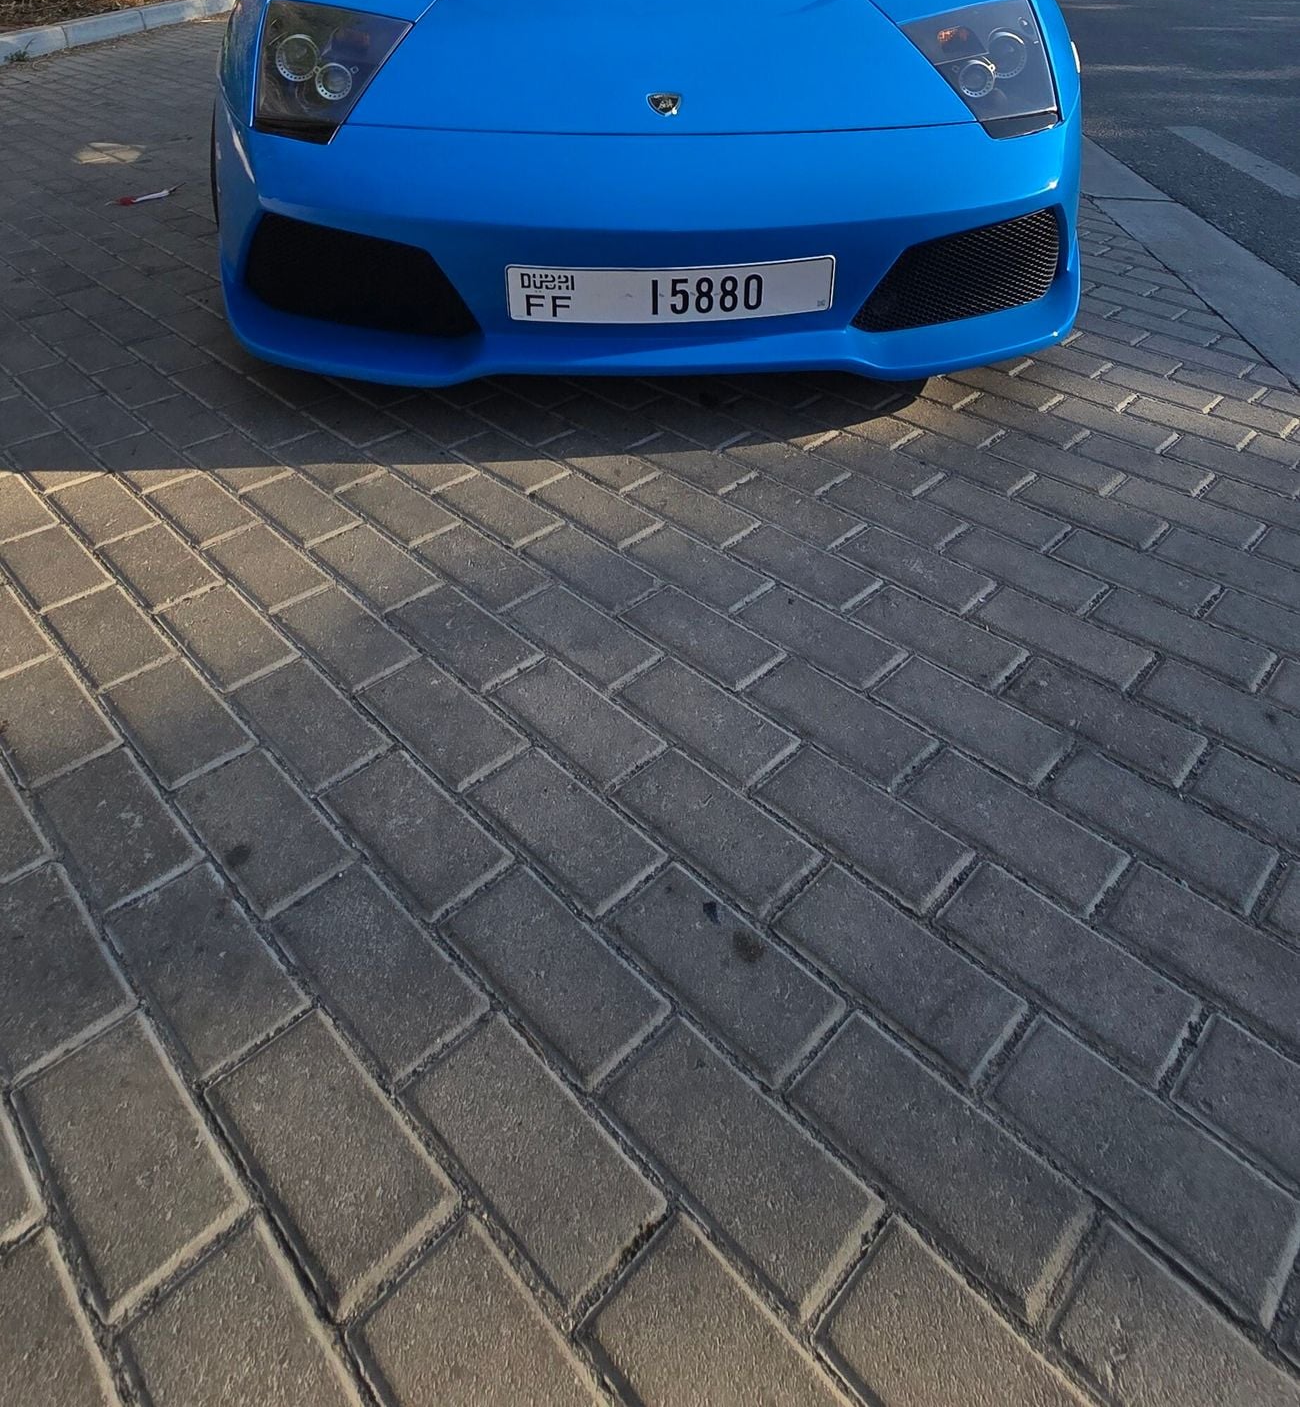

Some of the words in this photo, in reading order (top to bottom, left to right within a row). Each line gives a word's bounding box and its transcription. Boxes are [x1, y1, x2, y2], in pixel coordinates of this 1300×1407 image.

[520, 273, 575, 291] DUBAI
[525, 294, 572, 318] FF
[651, 274, 764, 315] 15880
